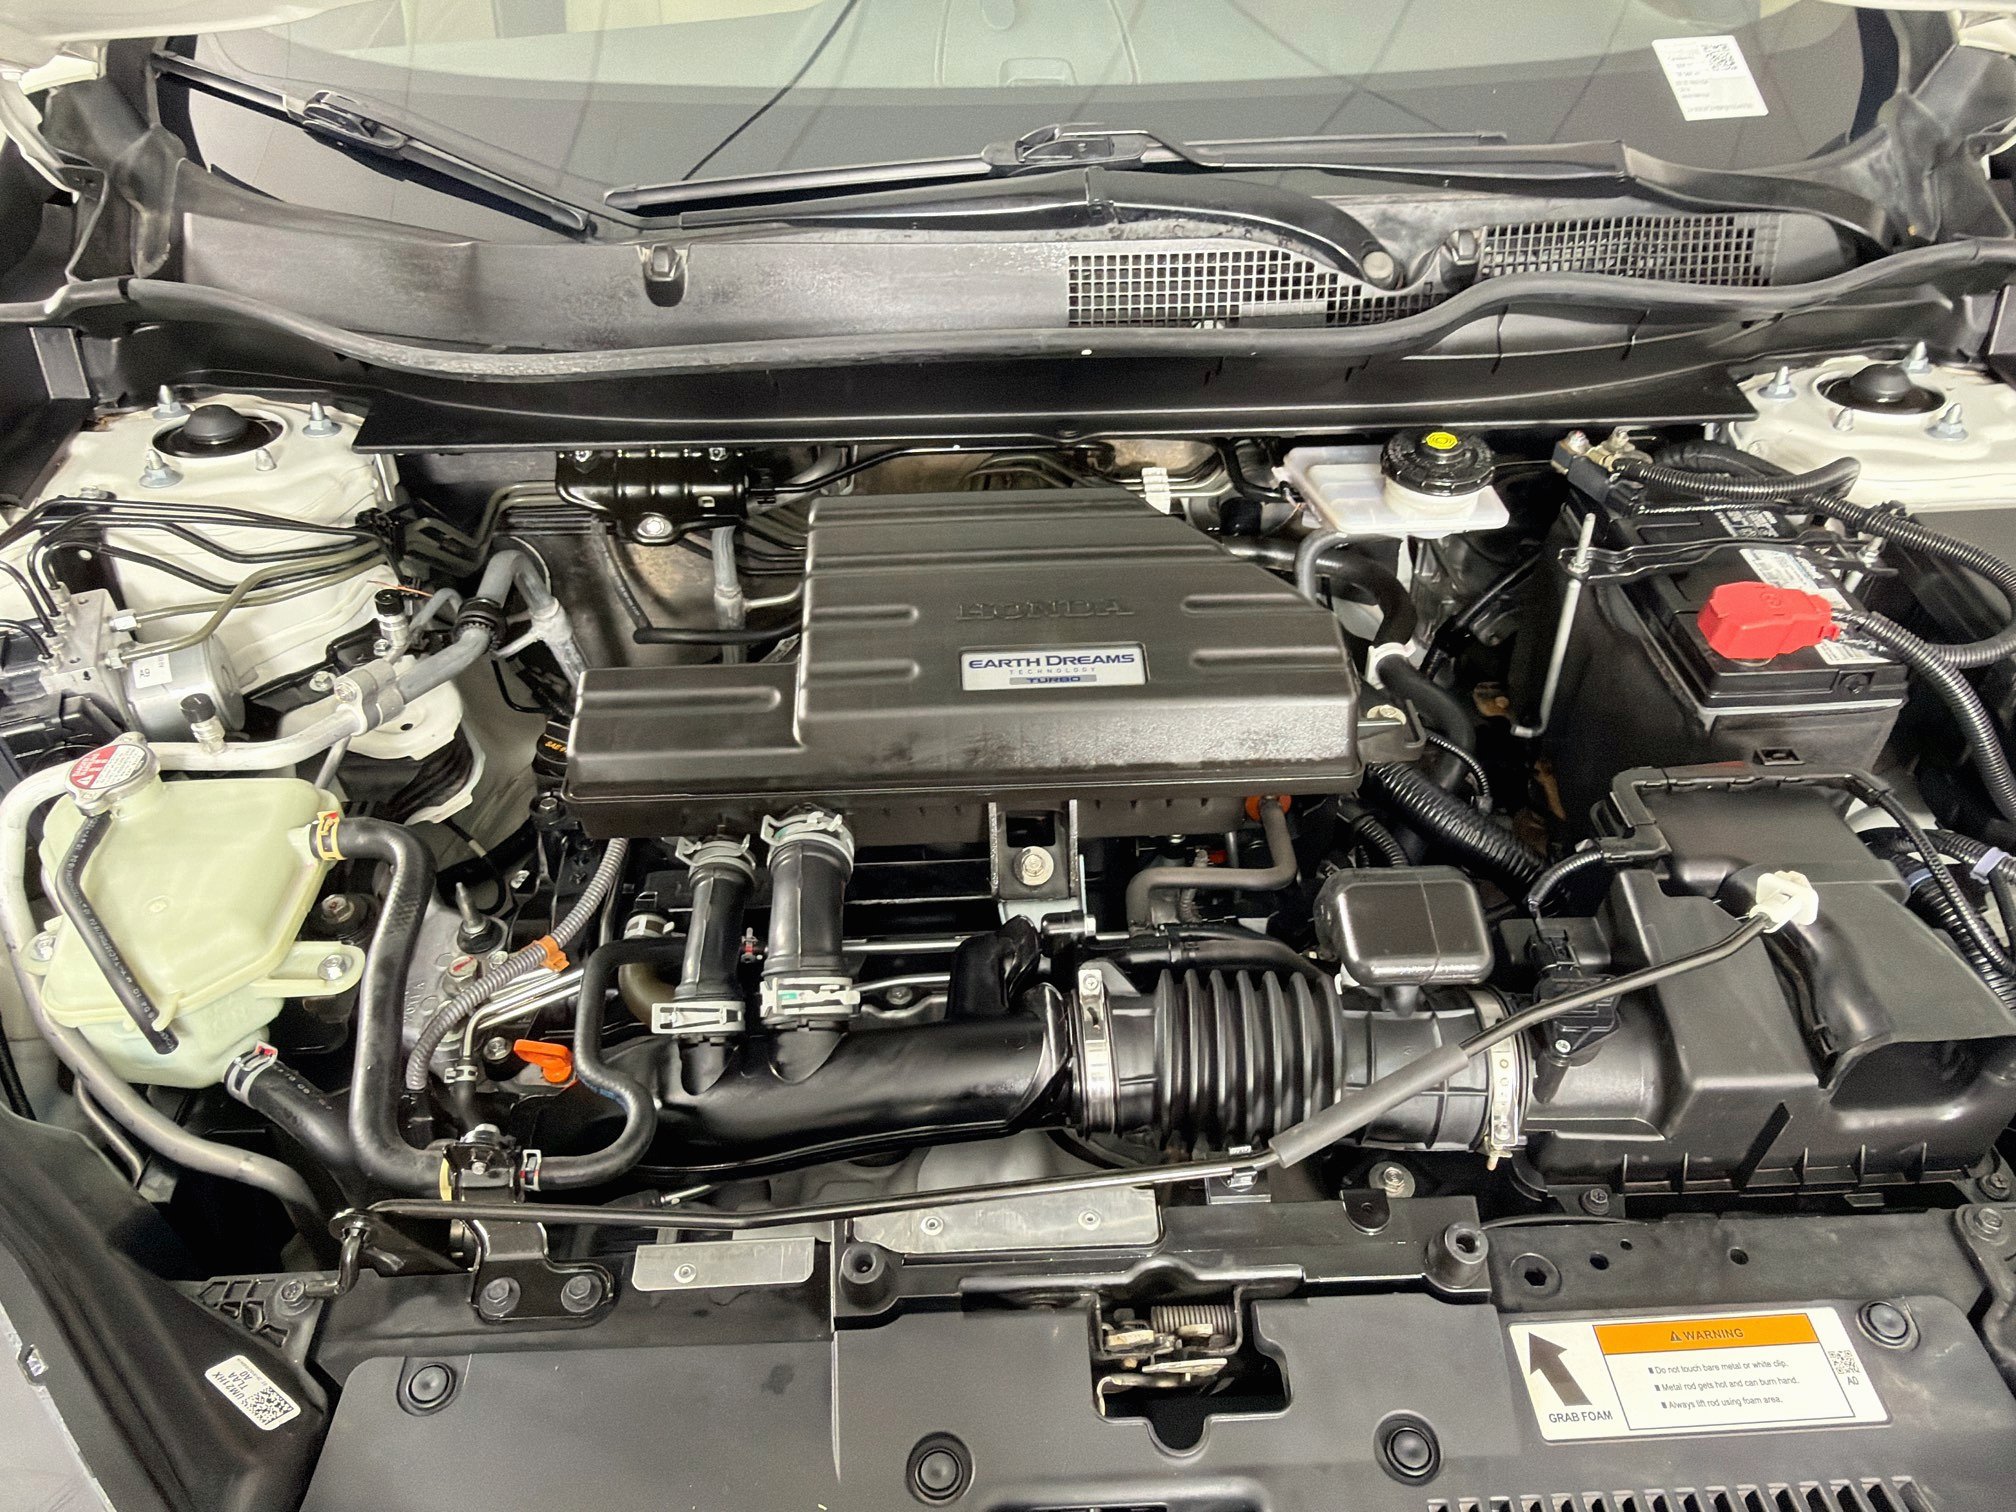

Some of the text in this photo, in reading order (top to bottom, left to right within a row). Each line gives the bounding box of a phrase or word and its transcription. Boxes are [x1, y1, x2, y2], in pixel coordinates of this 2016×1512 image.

[956, 600, 1135, 620] HONDA
[969, 654, 1135, 669] EARTH DREAMS
[1009, 667, 1096, 675] TECHNOLOGY
[1027, 675, 1081, 684] TURBO
[1682, 1328, 1744, 1341] WARNING
[1655, 1366, 1666, 1375] Do
[1667, 1365, 1680, 1374] not
[1681, 1363, 1702, 1373] touch
[1703, 1363, 1720, 1372] bare
[1721, 1362, 1742, 1371] metal
[1752, 1360, 1772, 1369] white
[1773, 1359, 1789, 1369] clip.
[1662, 1376, 1800, 1392] Metal rod gets hot and can burn hand.
[1669, 1396, 1783, 1410] Always lift rod using foam area.
[1548, 1410, 1613, 1423] GRAB FOAM
